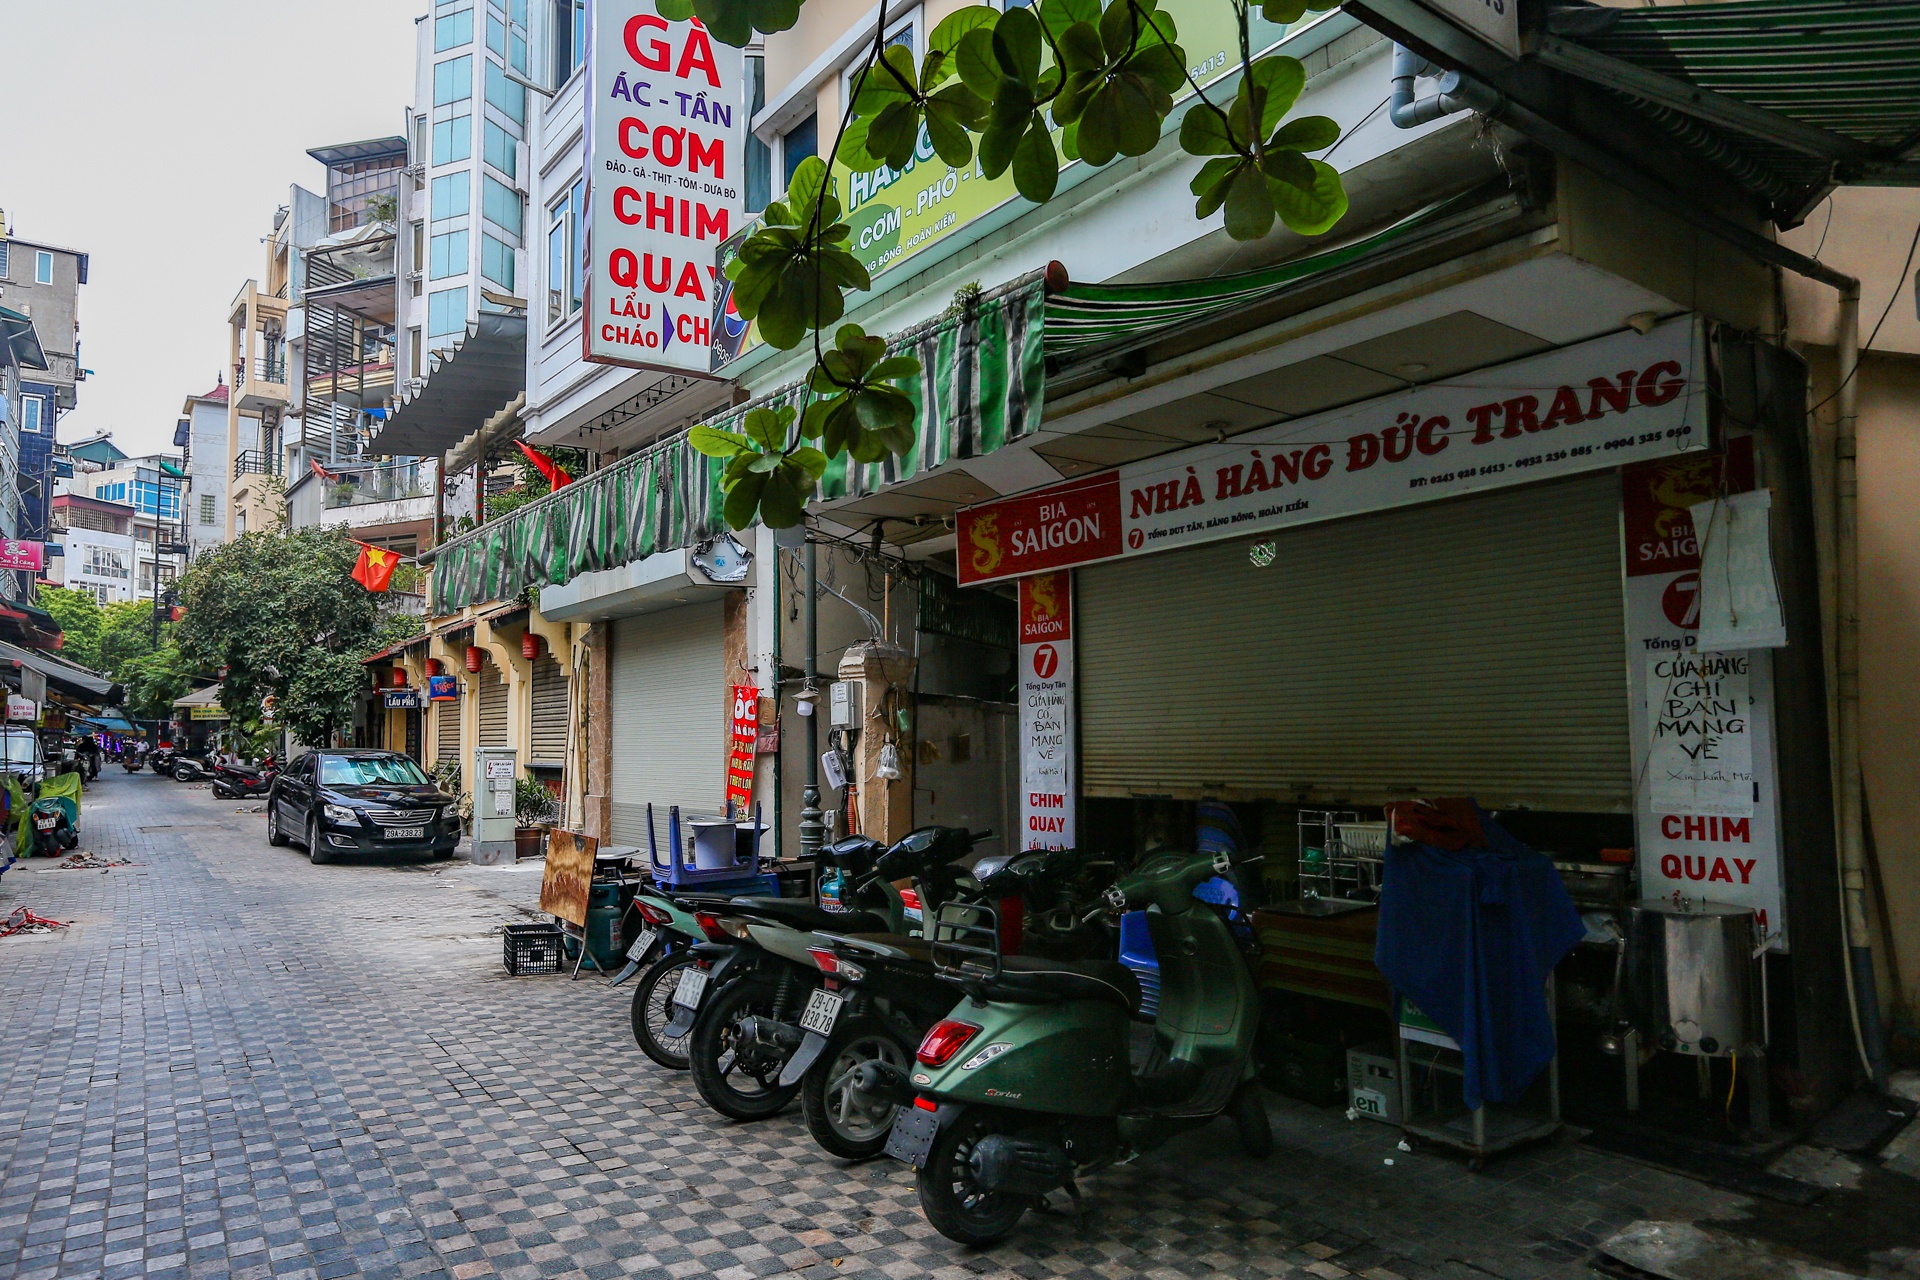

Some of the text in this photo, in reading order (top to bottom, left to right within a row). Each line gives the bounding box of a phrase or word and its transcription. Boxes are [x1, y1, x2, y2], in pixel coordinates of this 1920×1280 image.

[623, 14, 722, 89] GÀ
[611, 71, 651, 107] ÁC
[675, 90, 732, 129] TẦN
[618, 116, 725, 180] CƠM
[605, 159, 627, 175] ĐẢO
[633, 164, 646, 179] GÀ
[652, 170, 672, 187] THỊT
[678, 174, 698, 191] TÔM
[704, 182, 723, 198] DƯA
[613, 186, 729, 243] CHIM
[859, 205, 902, 250] CƠM
[906, 225, 932, 249] HOÀN
[934, 211, 956, 231] KIẾM
[609, 248, 716, 302] QUA
[601, 322, 658, 349] CHÁO
[1129, 360, 1687, 519] NHÀ HÀNG ĐỨC TRANG
[1430, 471, 1455, 486] 0243
[1457, 467, 1477, 480] 928
[1479, 461, 1506, 476] 5413
[1515, 455, 1543, 469] 0932
[1545, 449, 1567, 464] 236
[1039, 501, 1067, 522] BIA
[1131, 530, 1141, 548] 7
[1169, 526, 1185, 536] DUY
[1258, 505, 1283, 518] HOÀN
[1285, 498, 1309, 513] KIẾM
[1011, 513, 1101, 557] SAIGON
[1025, 620, 1063, 635] SAIGON
[1037, 614, 1050, 623] BIA
[1643, 636, 1681, 650] Tống
[1038, 648, 1052, 676] 7
[433, 680, 455, 693] Tiger
[1026, 682, 1040, 692] Tống
[1042, 683, 1054, 691] Duy
[1031, 734, 1063, 747] MANG
[1658, 718, 1747, 737] MANG
[1030, 794, 1064, 808] CHIM
[1029, 815, 1065, 833] QUAY
[1661, 815, 1751, 843] CHIM
[1661, 854, 1757, 885] QUAY
[812, 993, 837, 1014] 29-C1
[803, 1009, 832, 1032] 838.78
